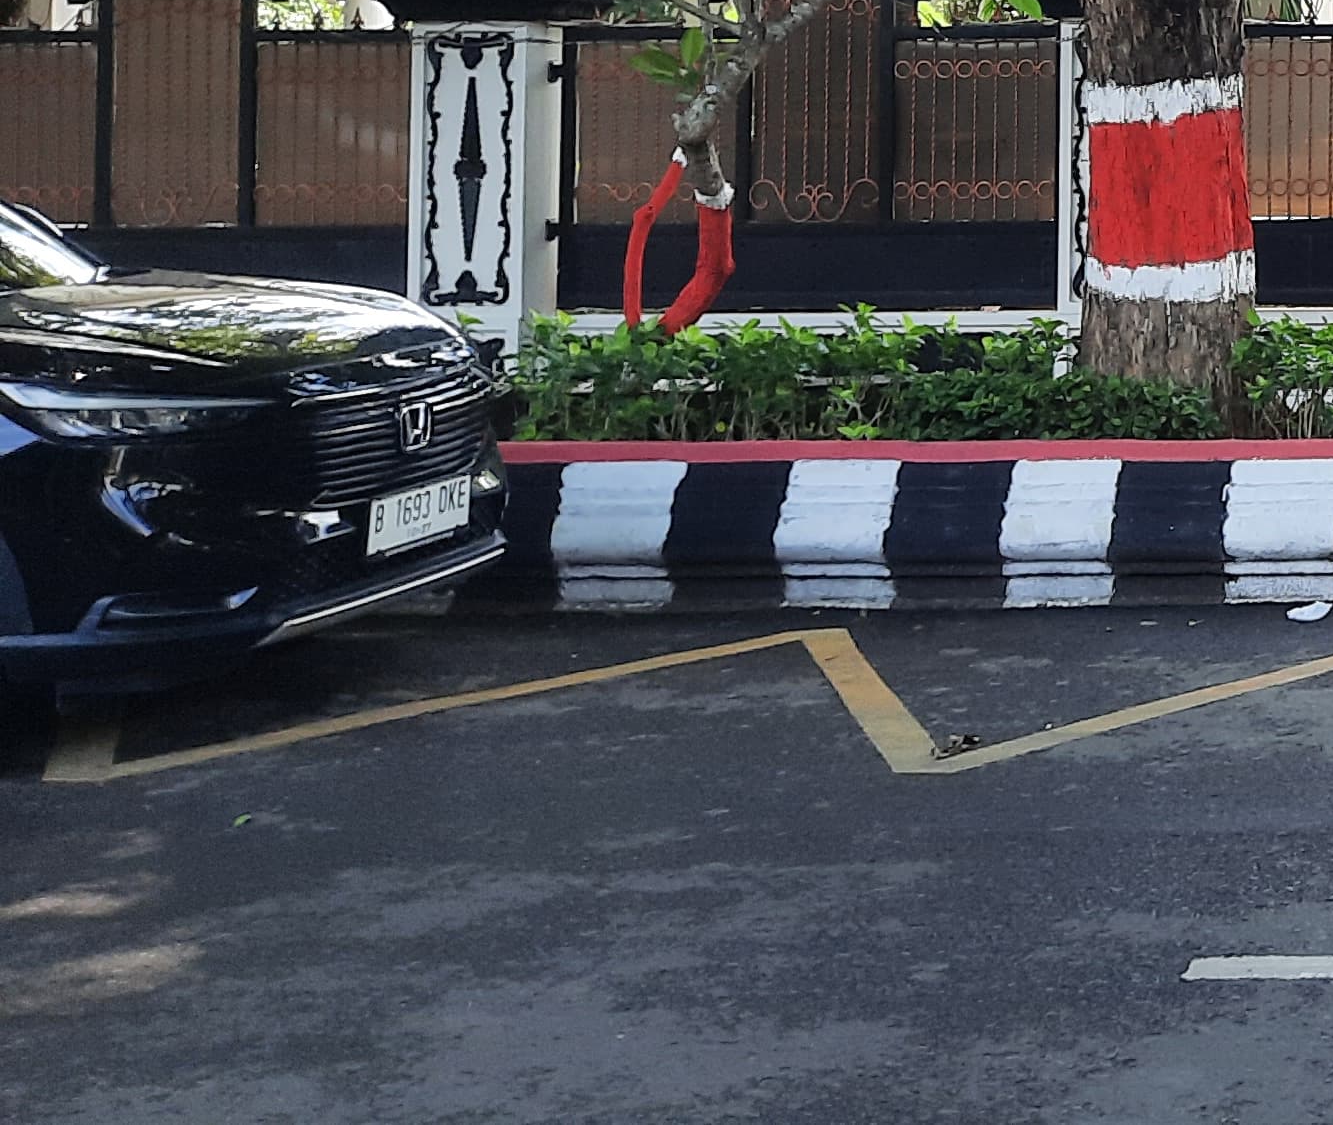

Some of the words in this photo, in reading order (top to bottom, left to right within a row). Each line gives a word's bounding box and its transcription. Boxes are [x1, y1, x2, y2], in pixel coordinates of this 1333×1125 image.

[375, 504, 384, 533] B
[396, 490, 431, 527] 1693
[438, 480, 466, 513] DKE
